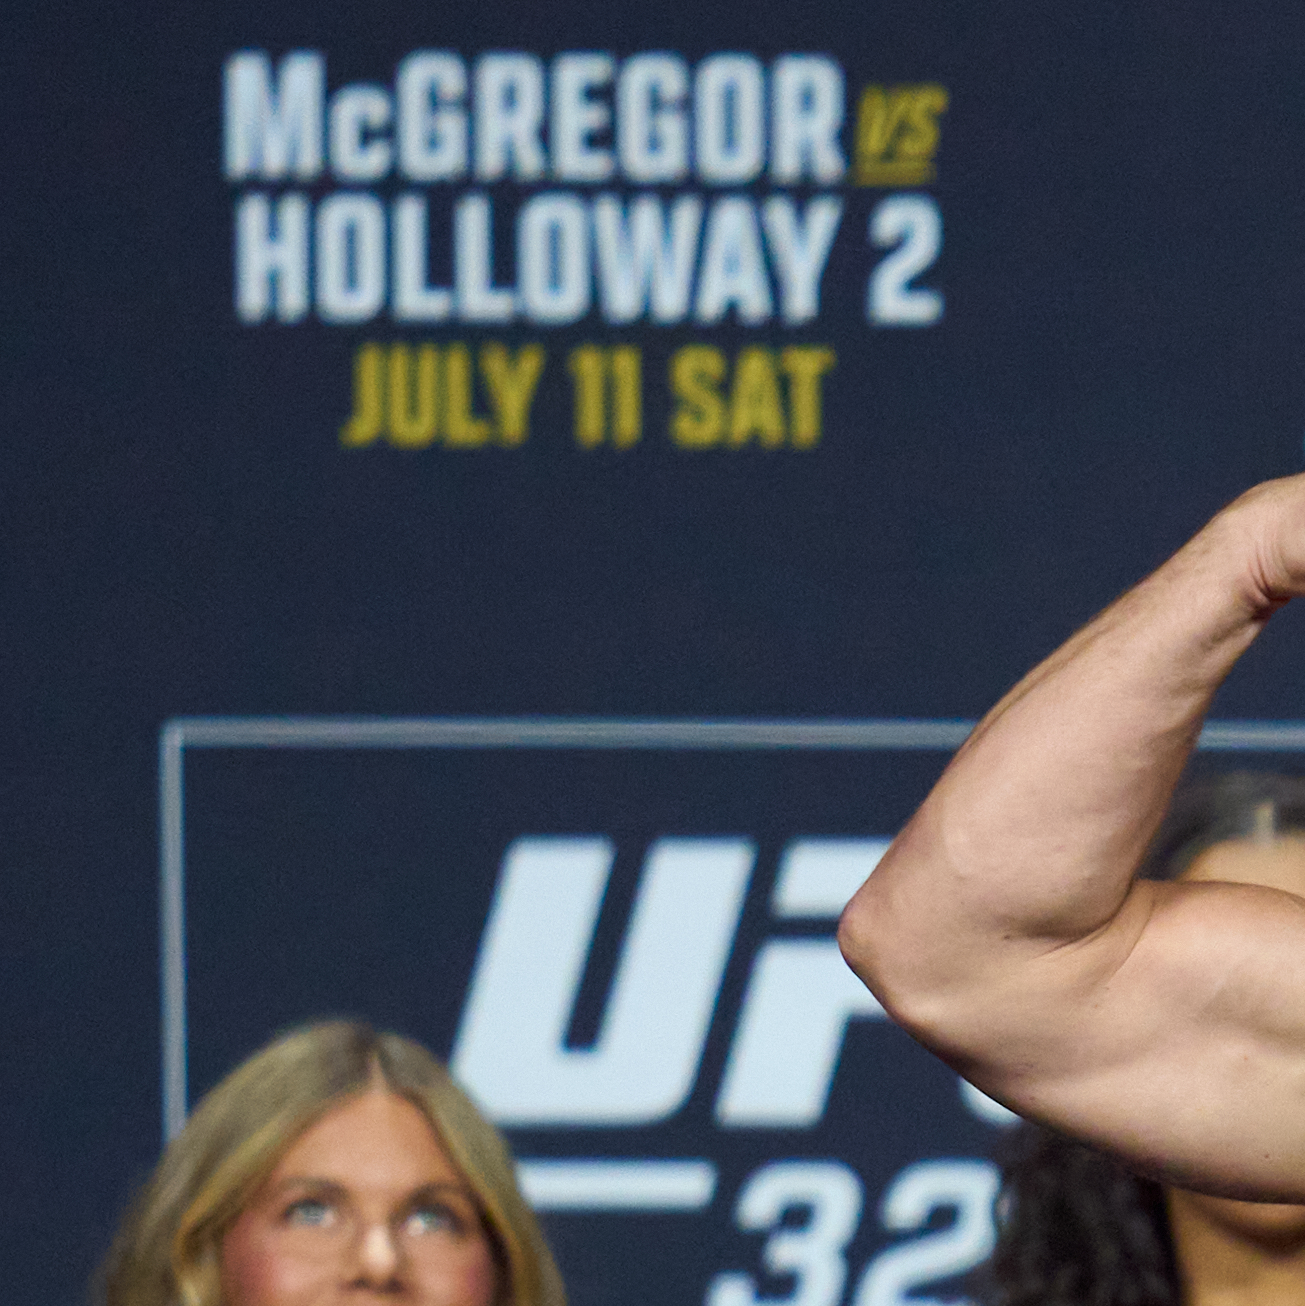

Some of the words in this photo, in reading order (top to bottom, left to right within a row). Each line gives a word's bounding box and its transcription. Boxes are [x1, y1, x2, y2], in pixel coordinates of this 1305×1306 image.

[223, 50, 847, 186] McGREGOR
[235, 192, 843, 325] HOLLOWAY
[867, 194, 944, 326] 2
[341, 343, 544, 448] JULY
[569, 344, 643, 448] 11
[669, 344, 836, 448] SAT
[452, 835, 1026, 1128] UF
